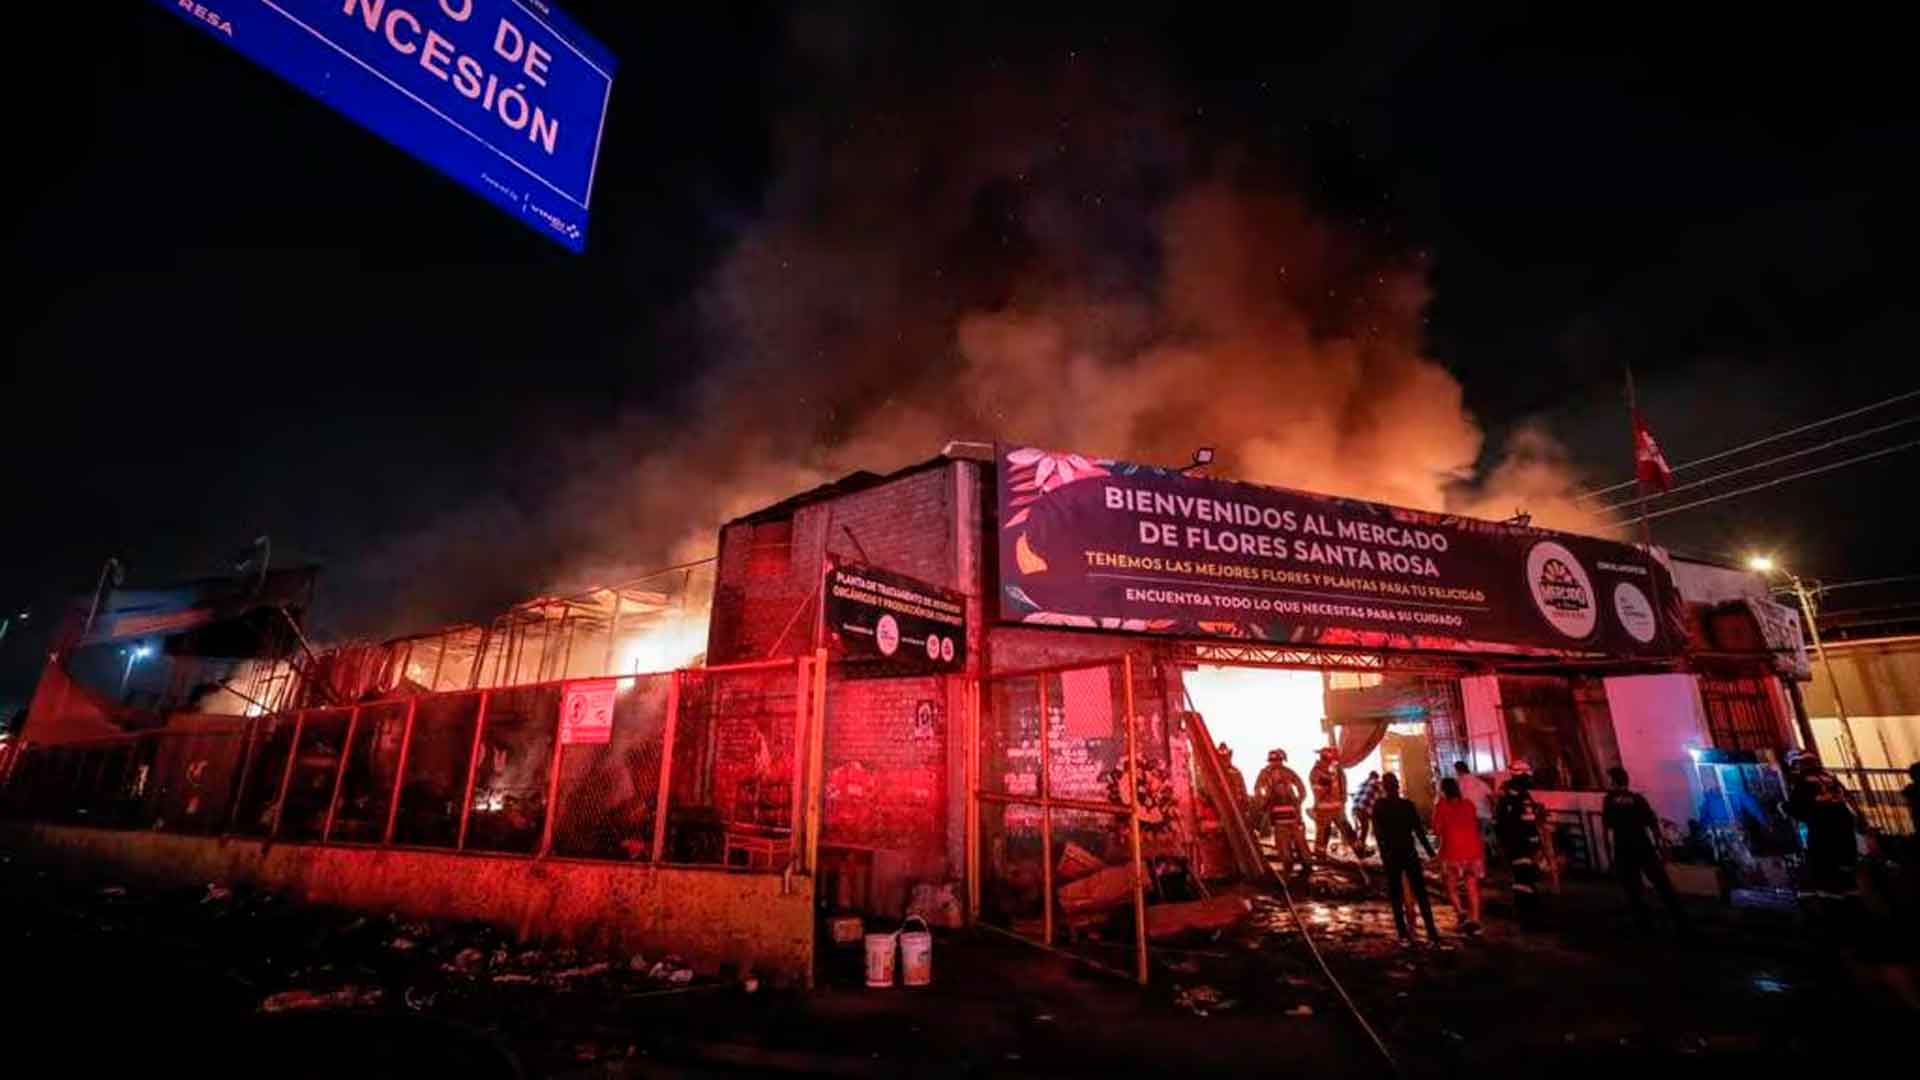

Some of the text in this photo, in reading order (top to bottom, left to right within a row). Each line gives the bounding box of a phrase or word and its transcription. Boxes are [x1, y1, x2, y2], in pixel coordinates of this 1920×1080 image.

[342, 0, 559, 156] NCESIÓN
[493, 18, 553, 88] DE
[1104, 486, 1448, 551] BIENVENIDOS AL MERCADO
[1139, 520, 1441, 578] DE FLORES SANTA ROSA
[1085, 550, 1486, 602] TENEMOS LAS MEJORES FLORES Y PLANTAS PARA TU FELICIDAD
[1125, 588, 1462, 627] ENCUENTRA TODO LO QUE NECESITAS PARA SU CUIDADO
